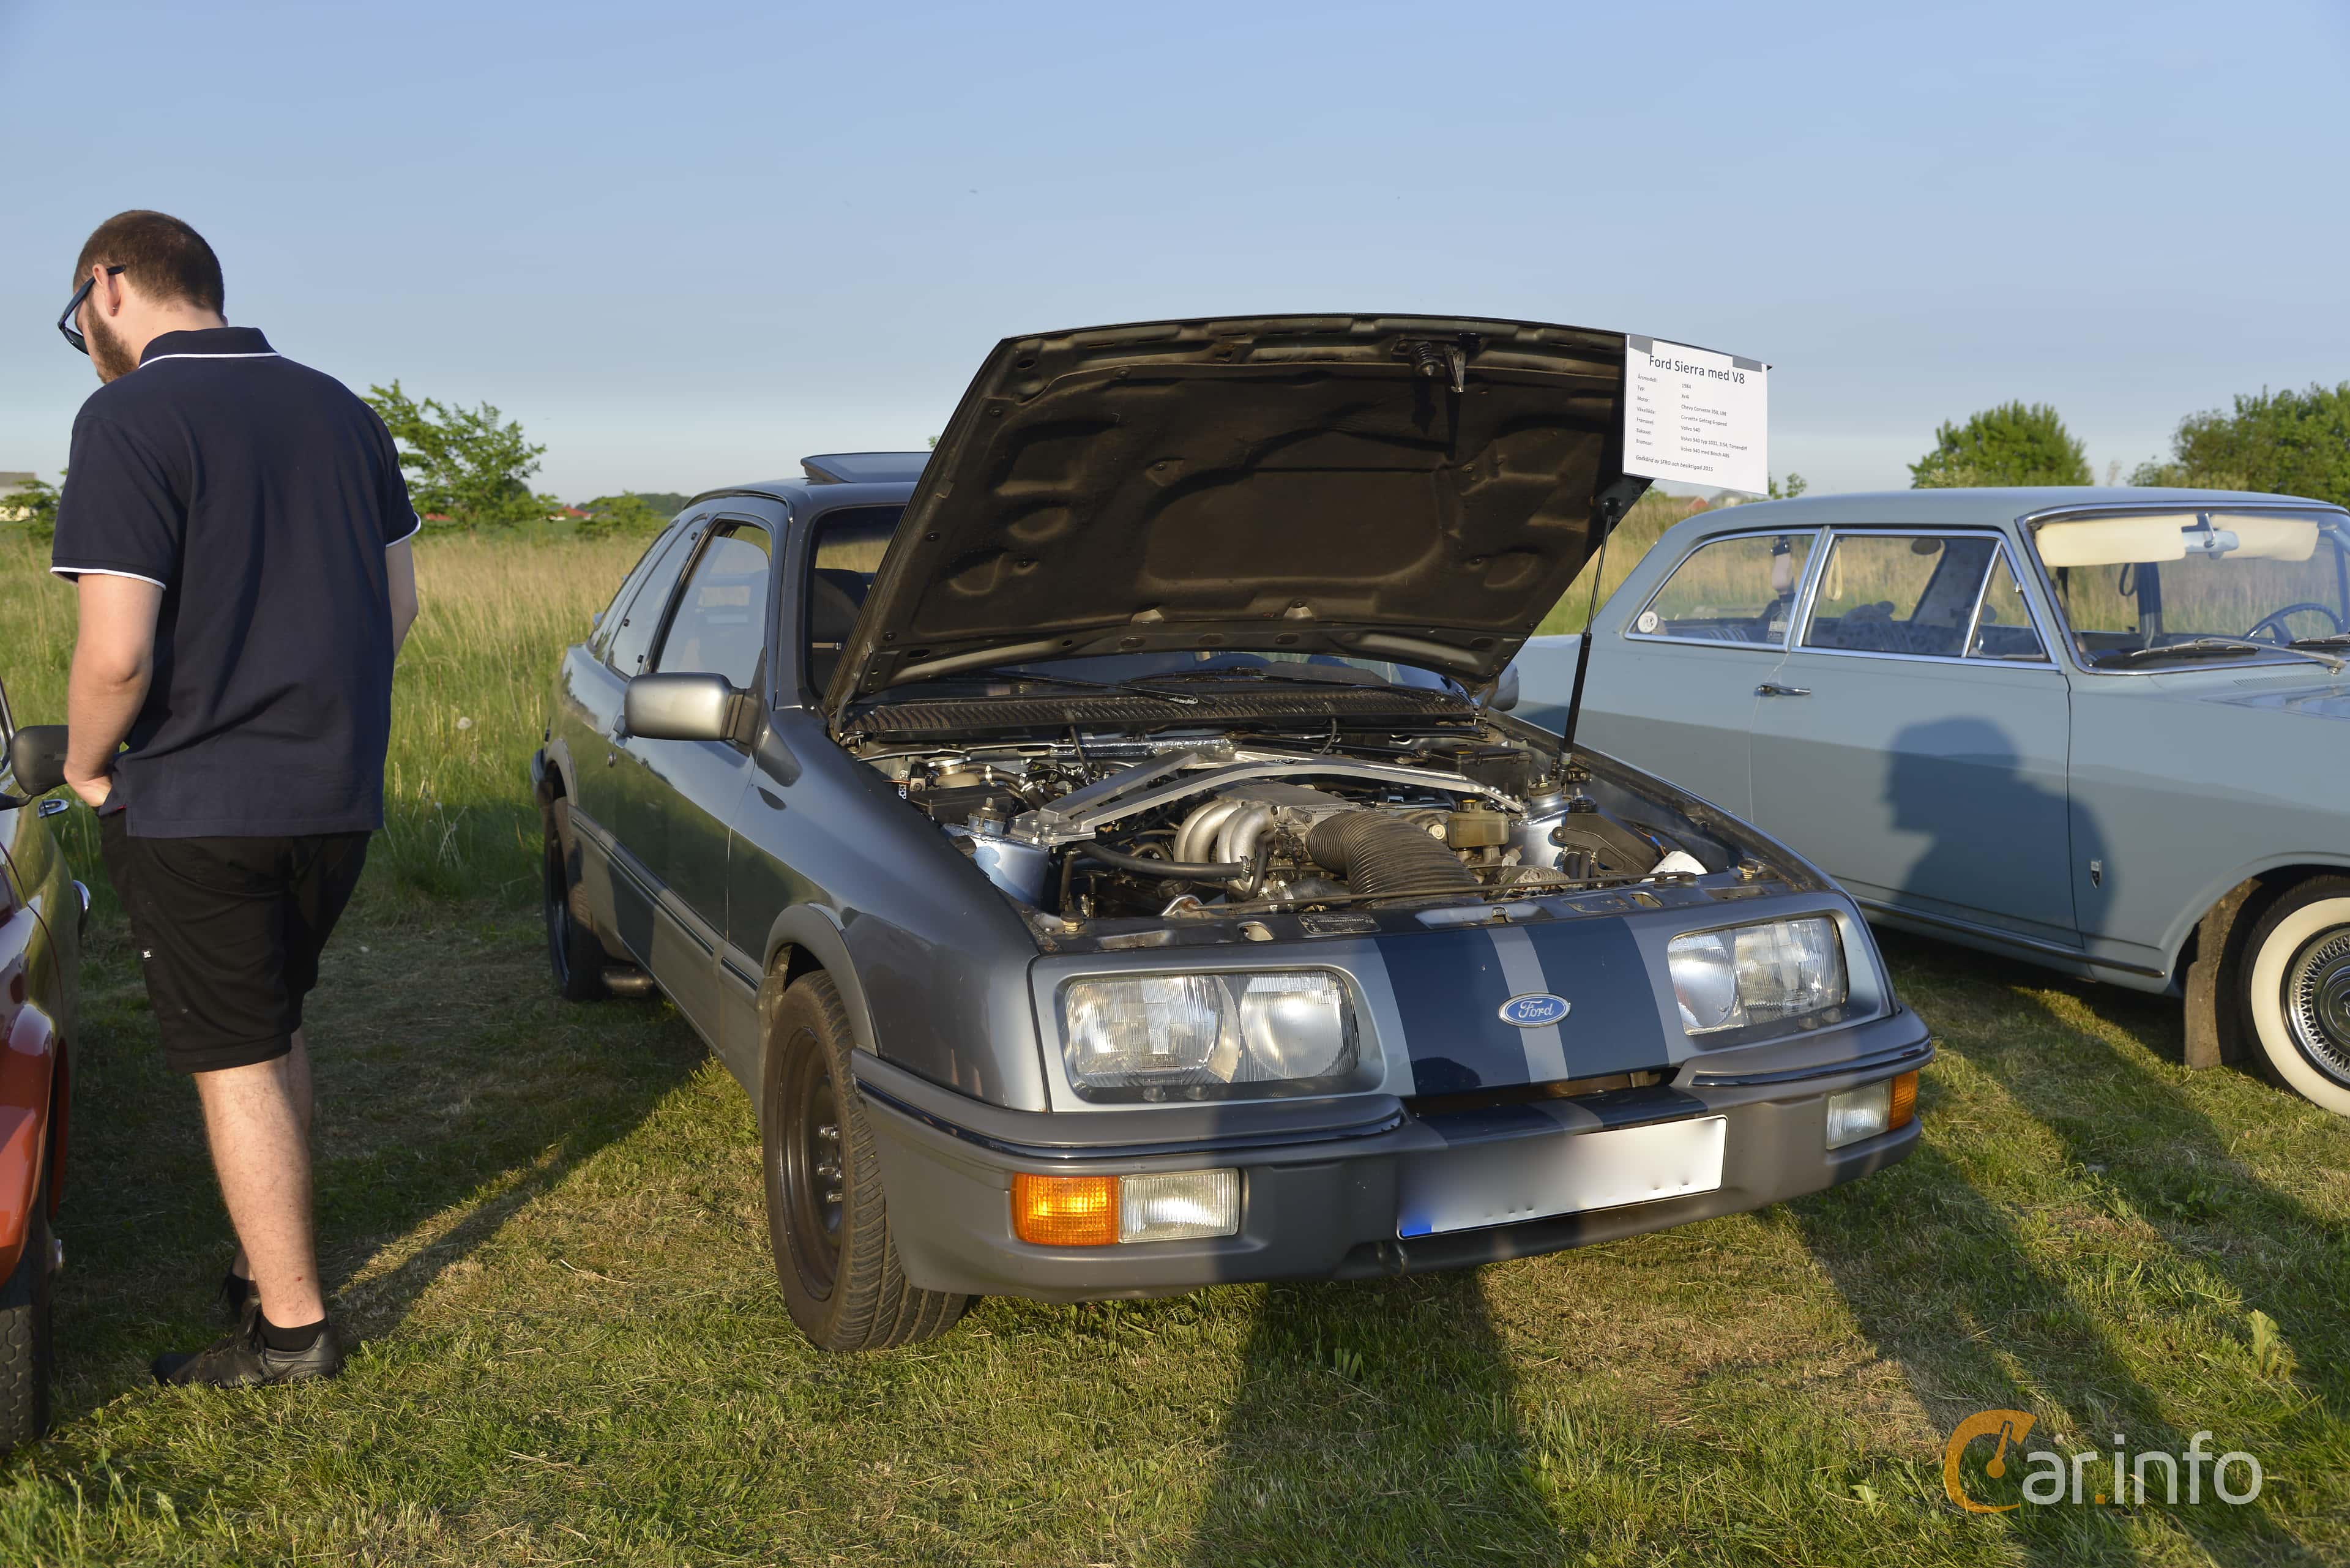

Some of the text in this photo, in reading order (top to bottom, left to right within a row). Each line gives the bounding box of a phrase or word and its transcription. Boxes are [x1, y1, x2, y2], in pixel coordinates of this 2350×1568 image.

[1650, 355, 1745, 384] Ford Sierra med V8
[1518, 999, 1554, 1018] Ford
